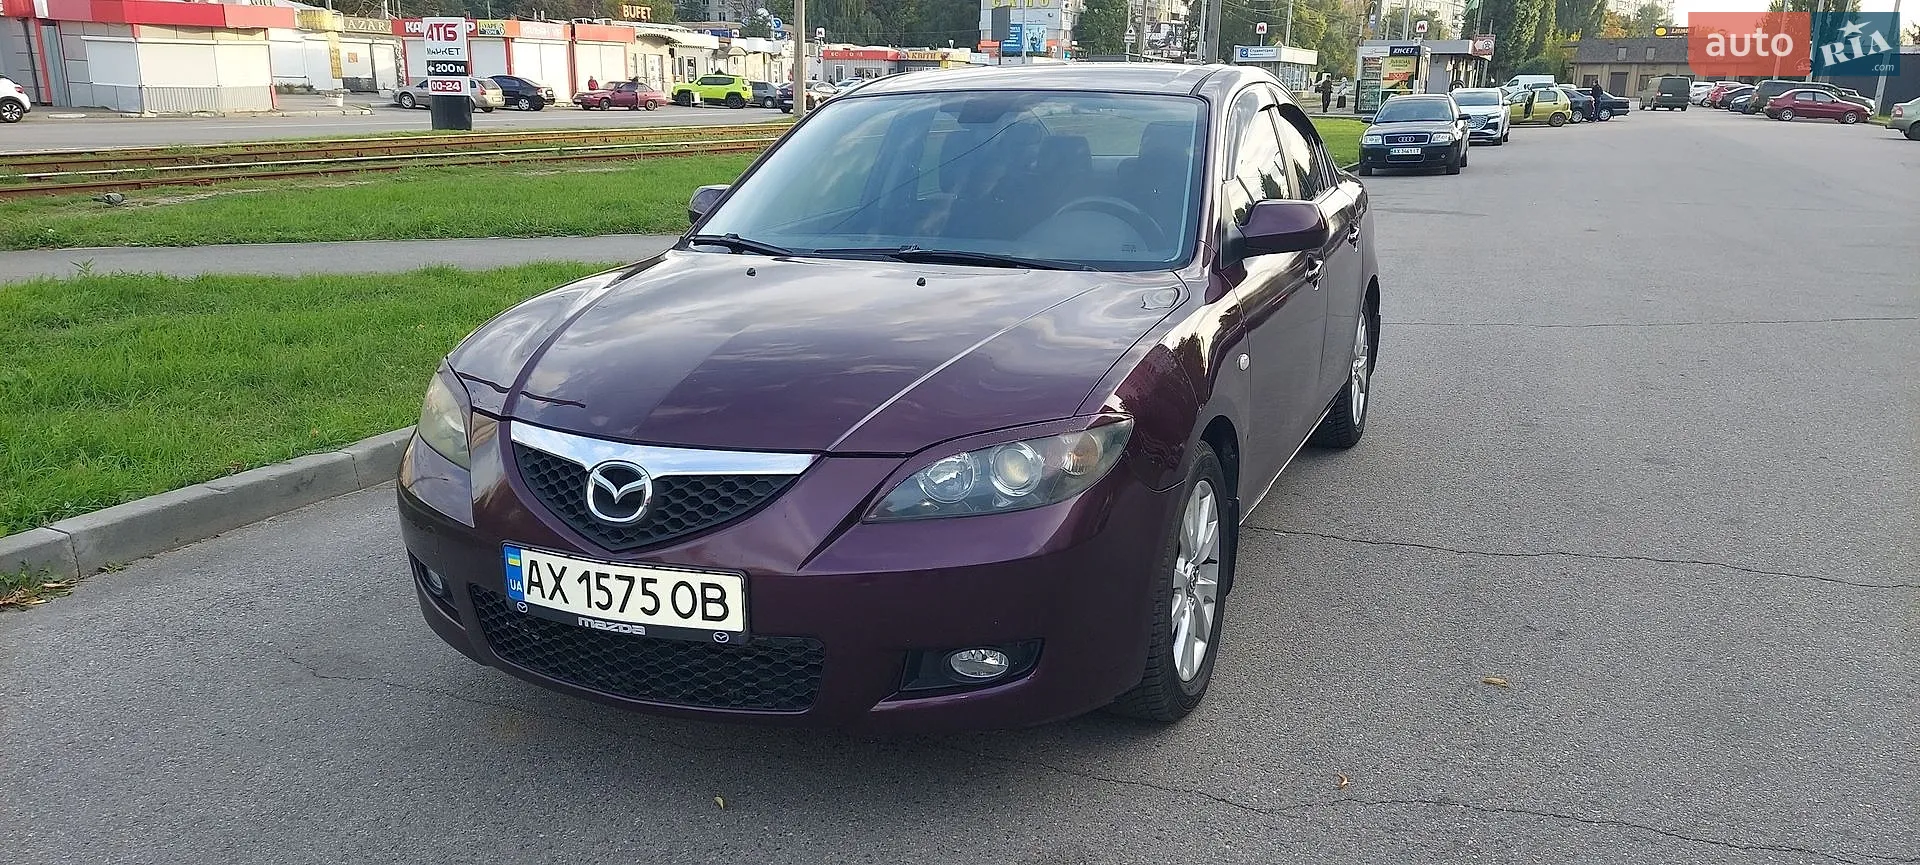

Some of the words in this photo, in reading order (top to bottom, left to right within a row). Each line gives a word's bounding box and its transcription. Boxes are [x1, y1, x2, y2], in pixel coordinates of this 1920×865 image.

[622, 4, 652, 20] BUFET
[426, 23, 458, 42] АТБ
[435, 63, 456, 73] 200
[431, 81, 461, 91] 00-24
[510, 578, 523, 593] UA
[526, 559, 570, 604] AX
[577, 570, 661, 616] 1575
[671, 580, 730, 622] OB
